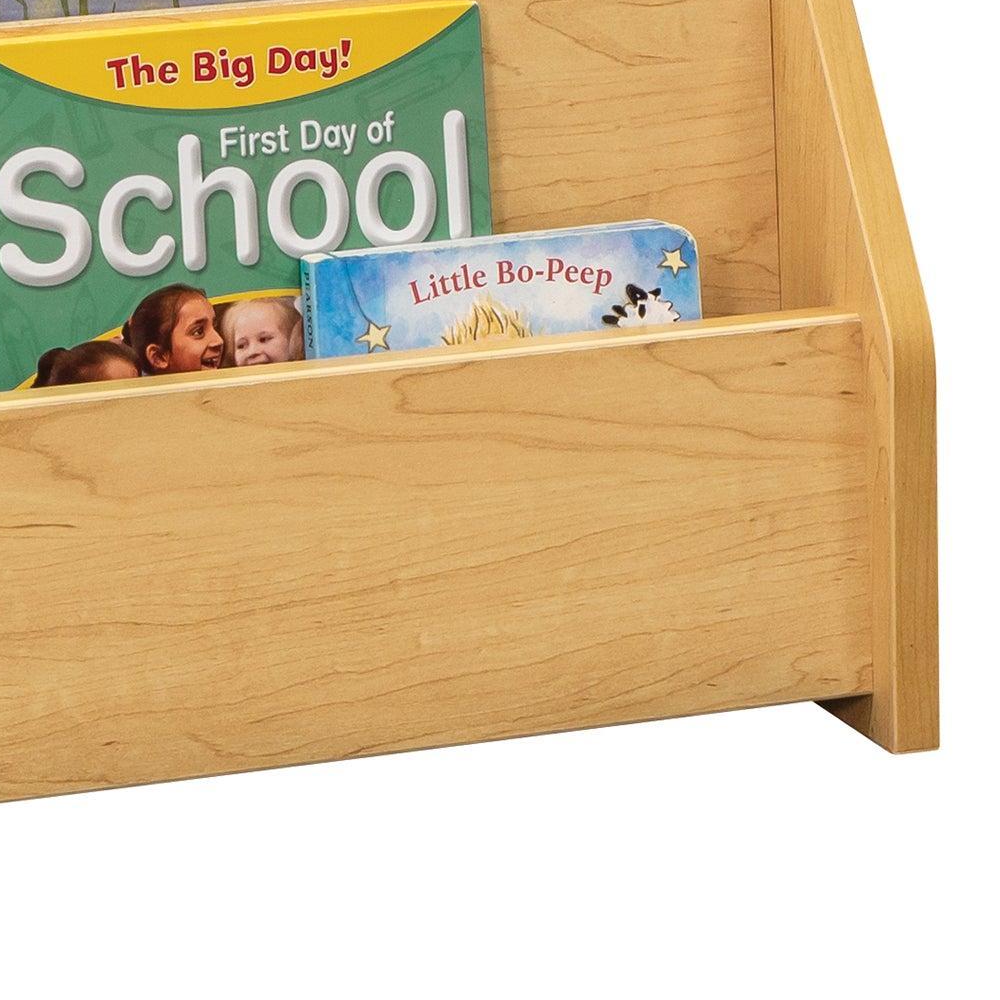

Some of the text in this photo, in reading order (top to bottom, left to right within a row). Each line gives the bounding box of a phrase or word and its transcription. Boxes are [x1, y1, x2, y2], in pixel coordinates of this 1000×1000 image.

[106, 38, 353, 91] The Big Day!
[219, 110, 395, 159] First Day of
[408, 257, 613, 305] Little Bo-Peep
